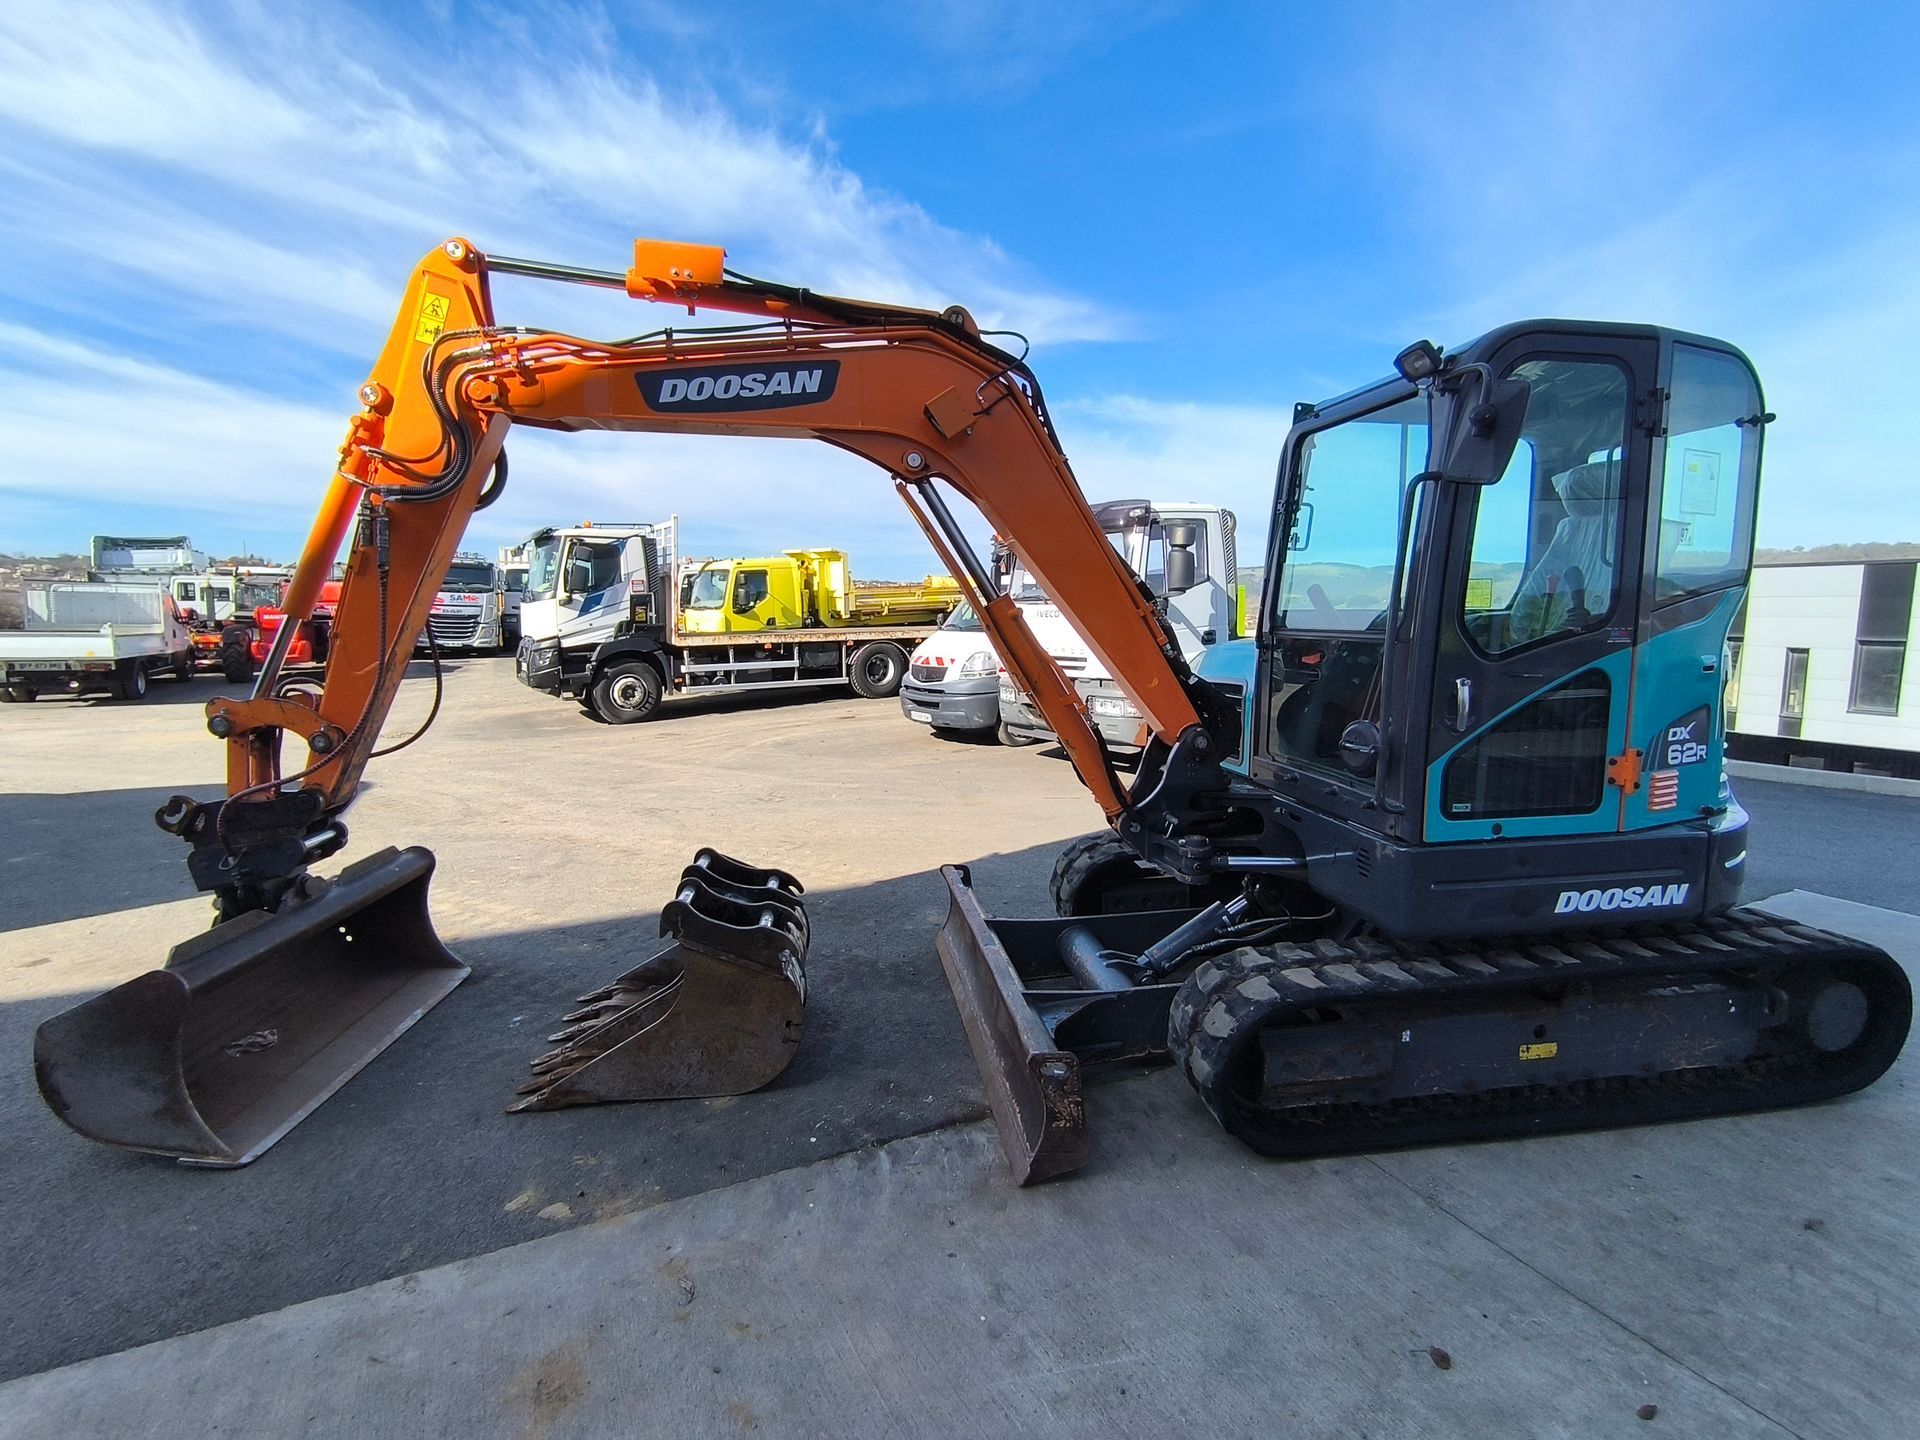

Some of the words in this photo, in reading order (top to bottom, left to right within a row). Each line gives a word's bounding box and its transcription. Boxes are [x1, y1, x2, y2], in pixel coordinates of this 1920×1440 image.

[659, 370, 823, 403] DOOSAN
[1036, 609, 1060, 618] IVECO
[1668, 721, 1696, 741] DX
[1667, 742, 1707, 765] 62R
[1554, 883, 1690, 914] DOOSAN
